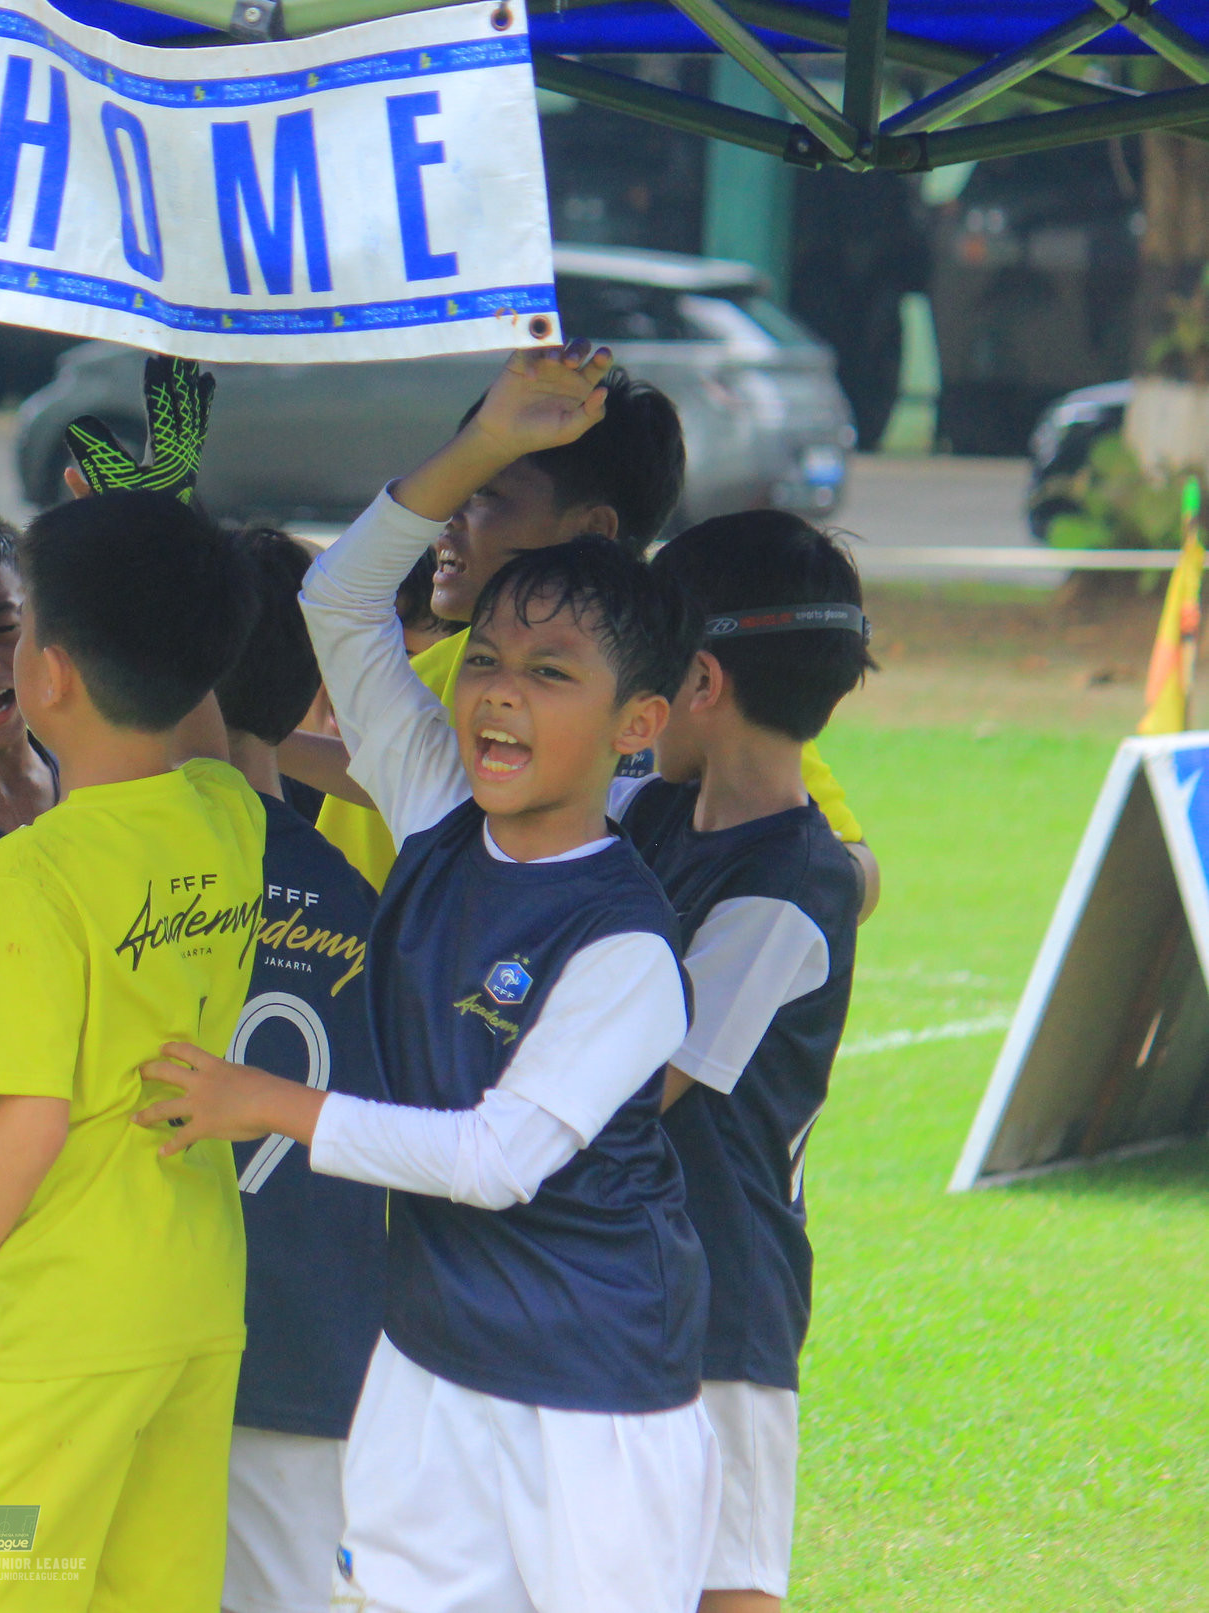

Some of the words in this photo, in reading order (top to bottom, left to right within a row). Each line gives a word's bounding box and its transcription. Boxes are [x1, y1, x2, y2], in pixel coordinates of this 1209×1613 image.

[170, 873, 218, 894] FFF
[268, 884, 320, 907] FFF
[264, 956, 313, 973] JAKARTA
[492, 984, 516, 999] FFF
